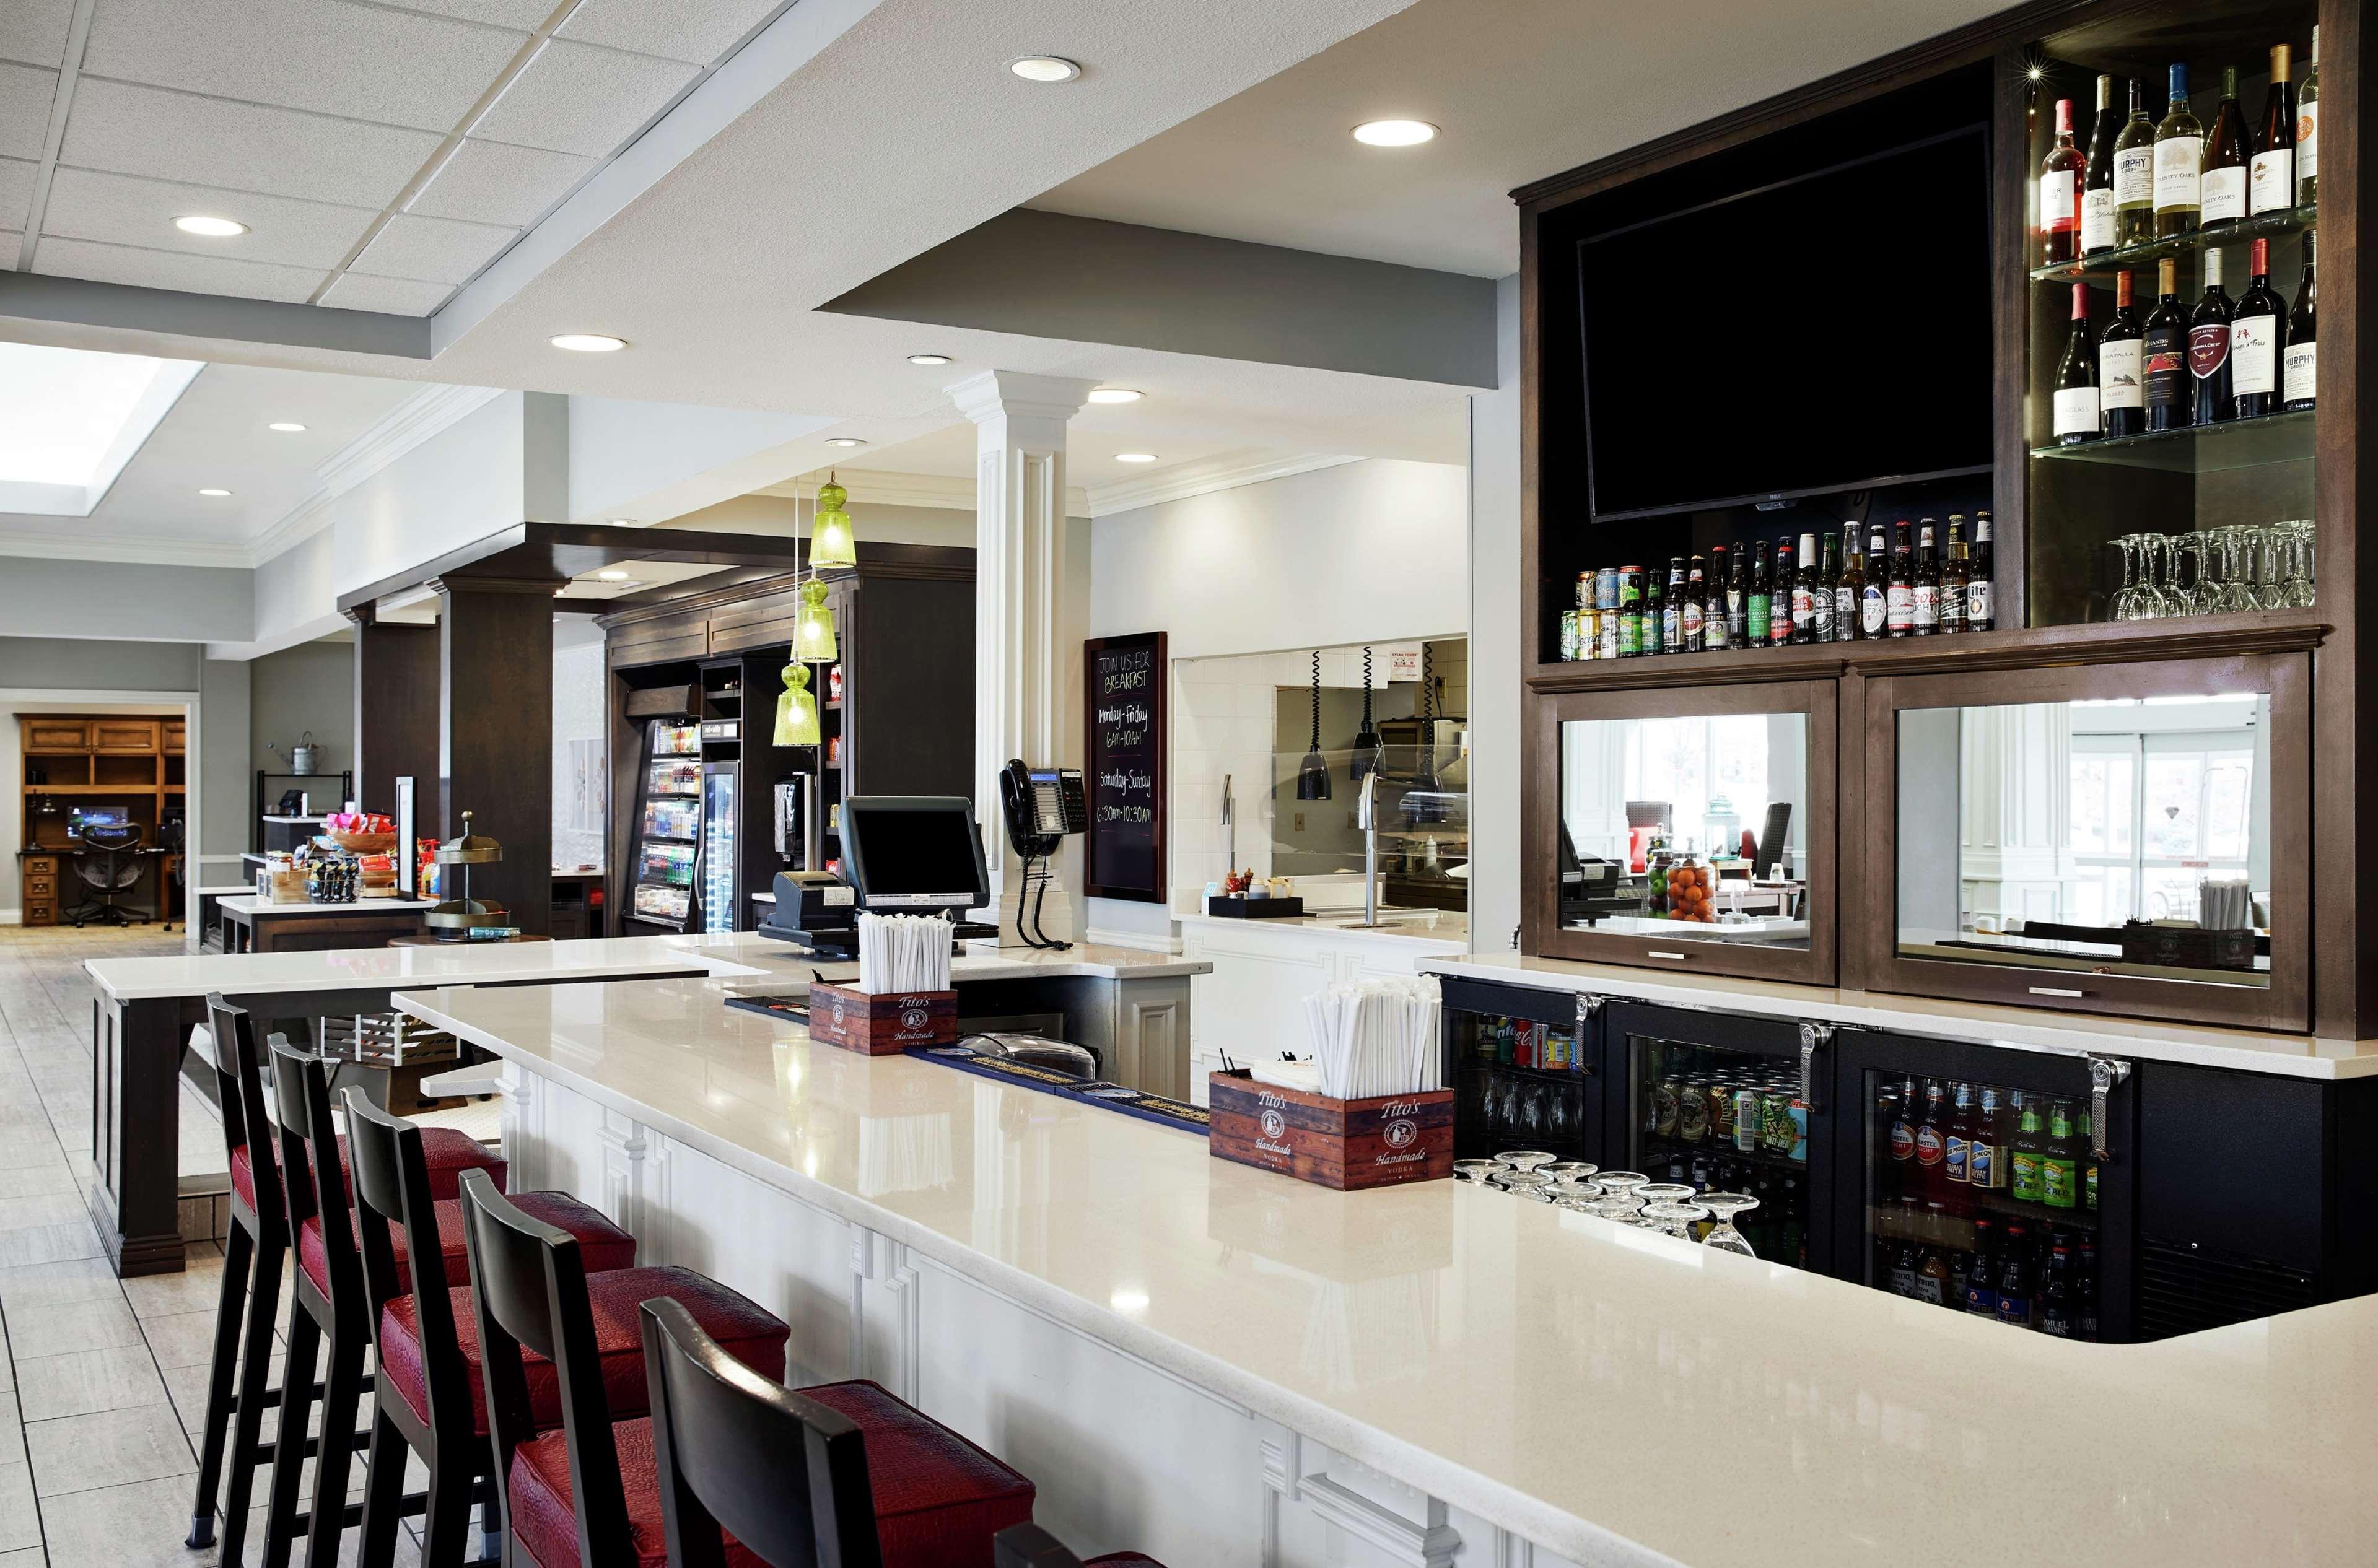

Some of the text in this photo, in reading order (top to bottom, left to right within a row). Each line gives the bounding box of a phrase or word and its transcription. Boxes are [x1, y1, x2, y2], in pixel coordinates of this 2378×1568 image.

[2148, 338, 2169, 347] HANDS
[2286, 354, 2315, 370] MURPHY
[1969, 586, 1987, 599] Lite
[1099, 651, 1150, 674] JOIN US FOR
[1104, 670, 1147, 694] BREAKFAST
[1099, 704, 1148, 732] Monday-Friday
[1100, 768, 1151, 798] Saturday-Sunday
[898, 995, 931, 1008] Tito's
[894, 1029, 935, 1040] Handmade
[1259, 1090, 1287, 1110] Tito's
[1381, 1099, 1421, 1118] Tito's
[1255, 1137, 1292, 1156] Handmade
[1953, 1144, 1969, 1152] MOON
[1977, 1151, 1993, 1159] MOON
[1375, 1147, 1425, 1166] Handmade
[1388, 1165, 1413, 1174] VODKA
